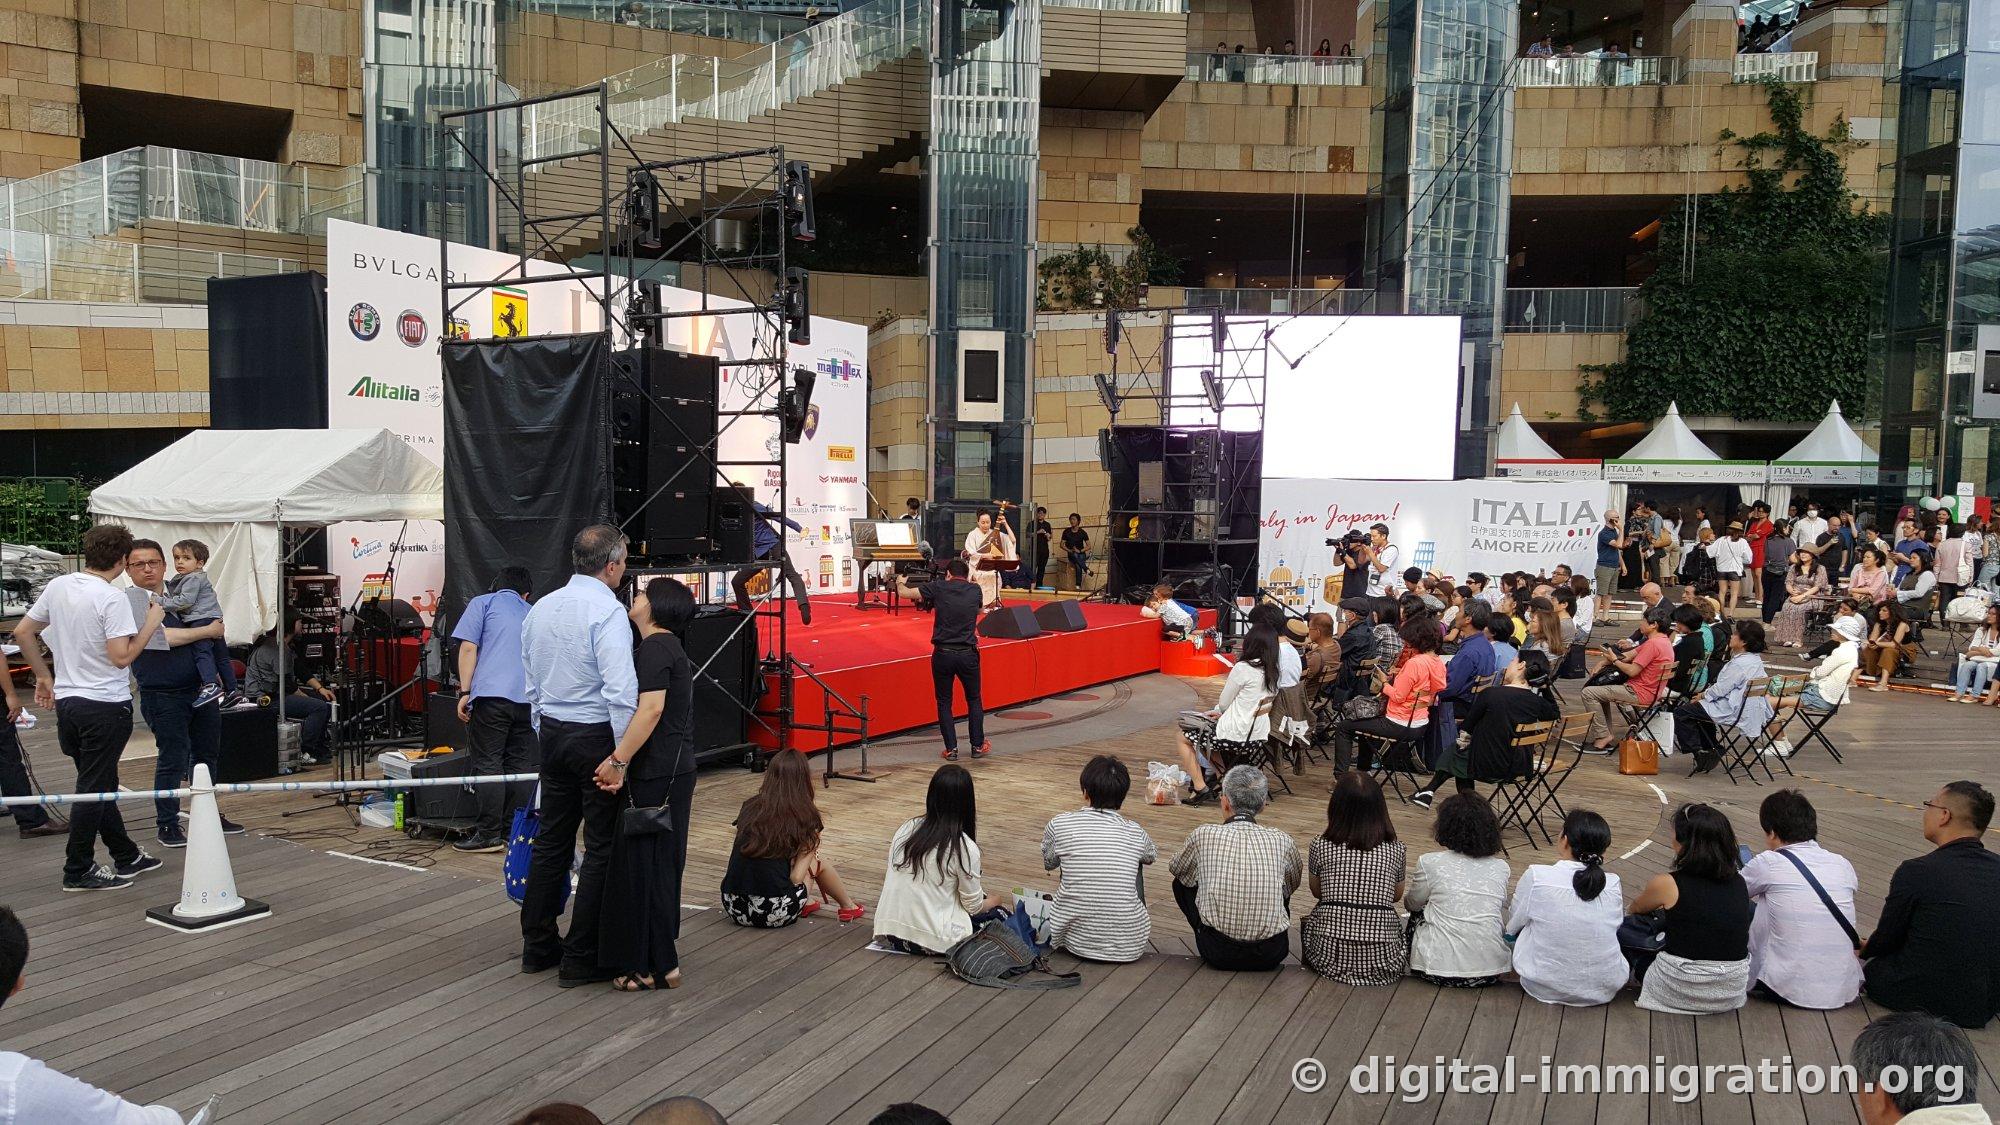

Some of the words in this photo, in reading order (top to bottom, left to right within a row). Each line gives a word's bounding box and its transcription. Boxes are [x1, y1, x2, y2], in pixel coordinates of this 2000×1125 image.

[353, 252, 468, 285] BVLGARI
[404, 319, 422, 338] FIAT
[816, 362, 862, 379] magniflex
[348, 376, 420, 402] Alitalia
[829, 448, 853, 459] PIRELLI
[1535, 469, 1598, 477] 株式会社バイオバランス
[1607, 465, 1644, 473] ITALIA
[1773, 467, 1812, 475] ITALIA
[830, 475, 858, 484] YANMAR
[1259, 509, 1288, 539] aly
[1294, 510, 1318, 525] in
[1325, 502, 1400, 531] Japan!
[1472, 498, 1598, 526] ITALIA
[1471, 525, 1561, 539] 日伊国交150周年記念
[1471, 538, 1538, 553] AMORE
[1540, 524, 1601, 553] mio!
